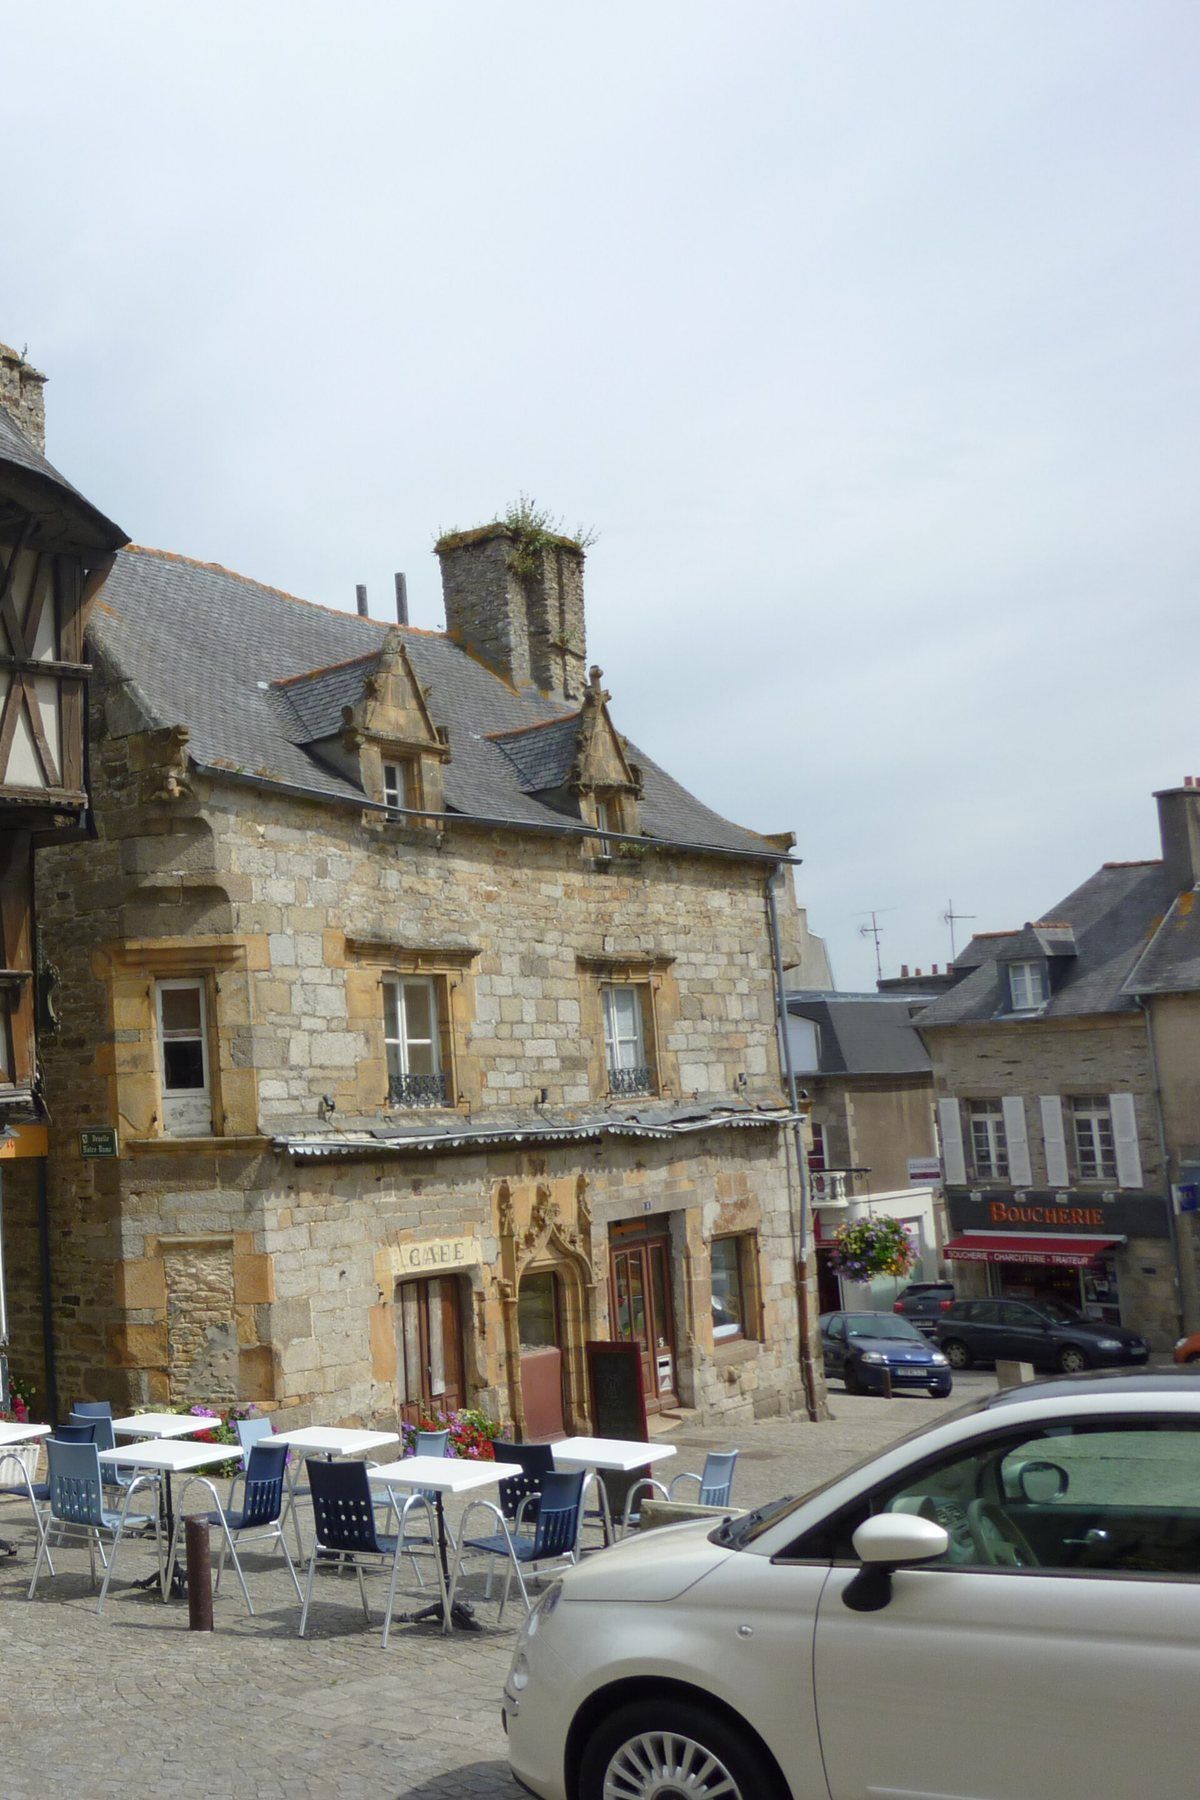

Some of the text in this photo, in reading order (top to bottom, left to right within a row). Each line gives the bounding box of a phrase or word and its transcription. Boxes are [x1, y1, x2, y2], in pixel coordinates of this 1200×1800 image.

[990, 1201, 1104, 1225] BOUCHERIE
[948, 1251, 1089, 1265] BOUCHERIE CHARCUTERIE TRAITEUR
